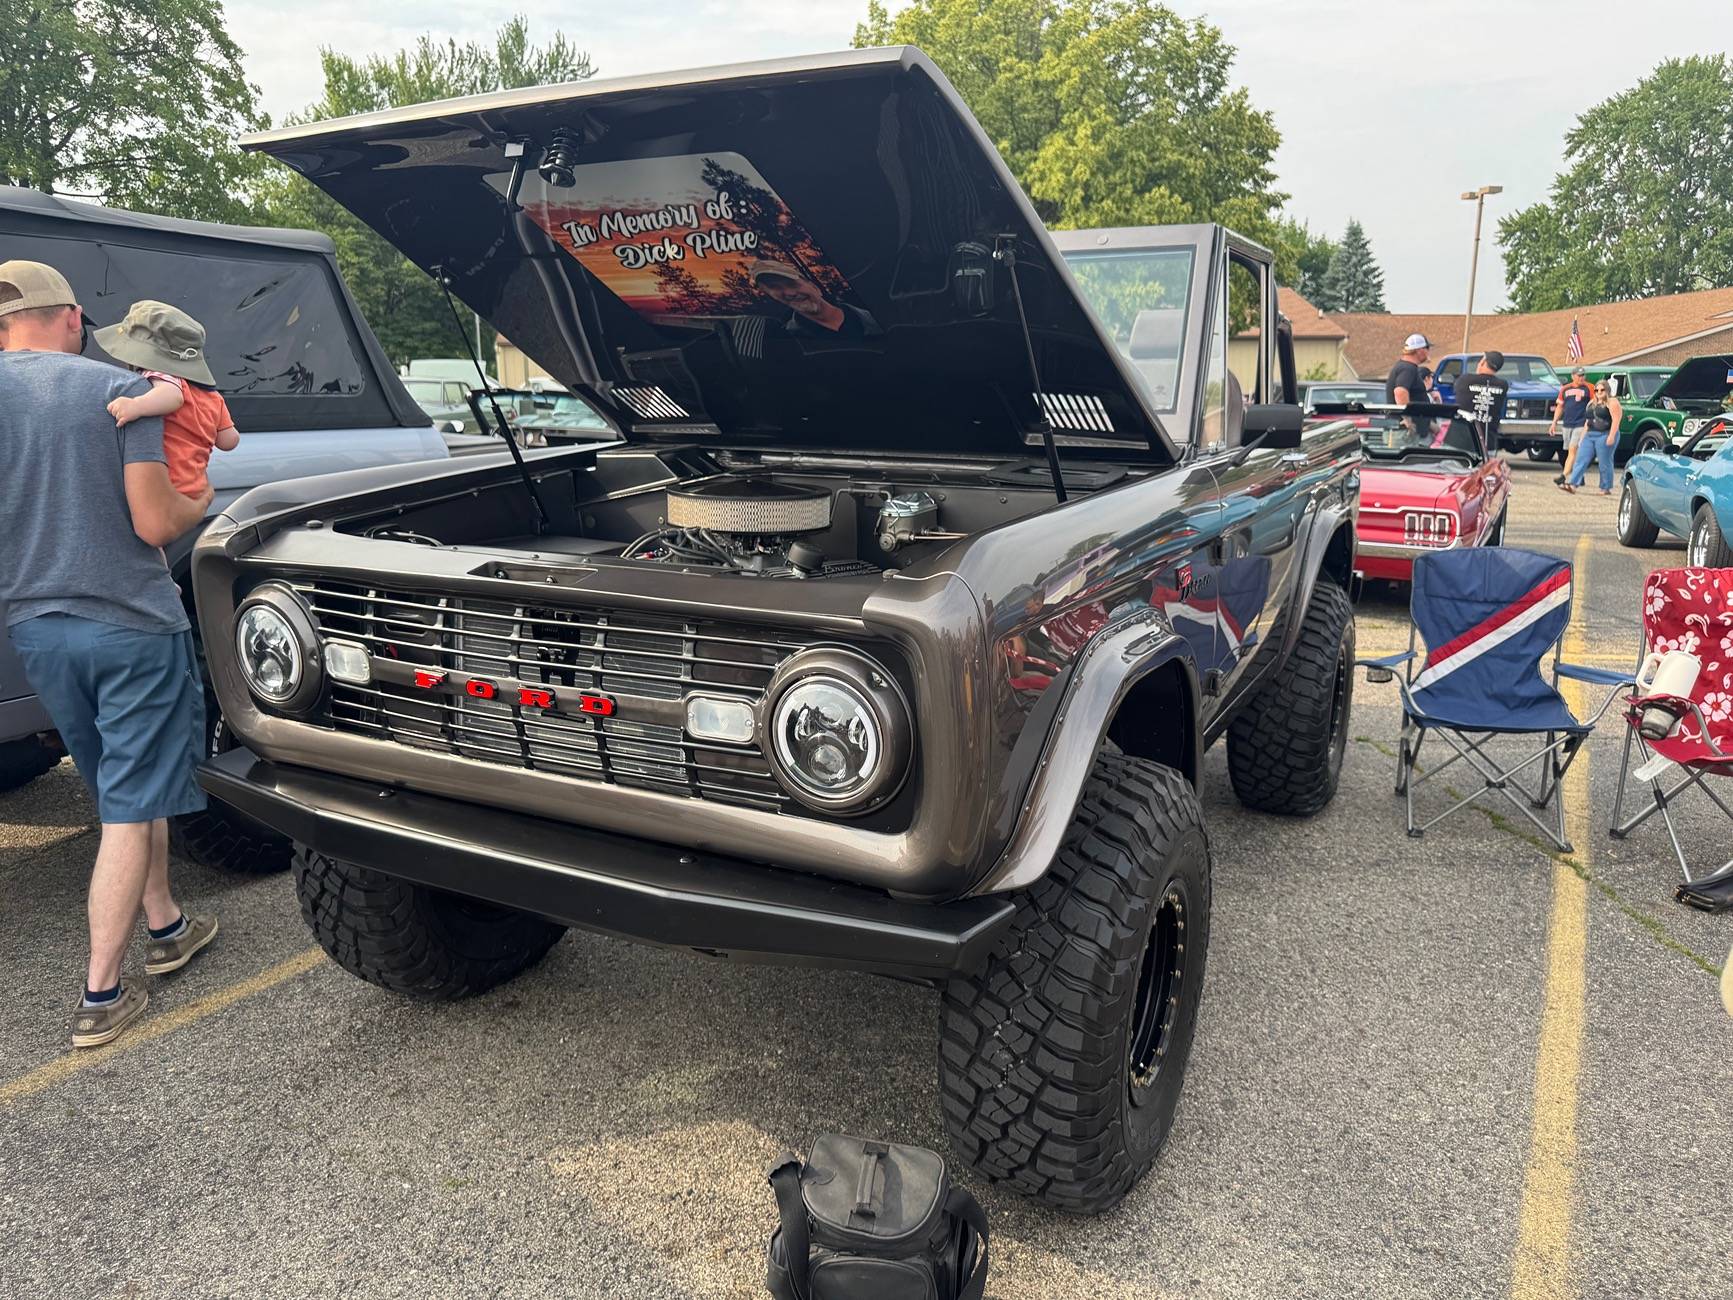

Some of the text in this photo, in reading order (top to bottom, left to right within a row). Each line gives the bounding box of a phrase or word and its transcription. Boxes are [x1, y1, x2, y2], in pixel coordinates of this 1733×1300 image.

[563, 220, 598, 247] In
[600, 204, 699, 239] Memory
[614, 230, 758, 270] Dick Pline
[413, 668, 617, 717] FORD
